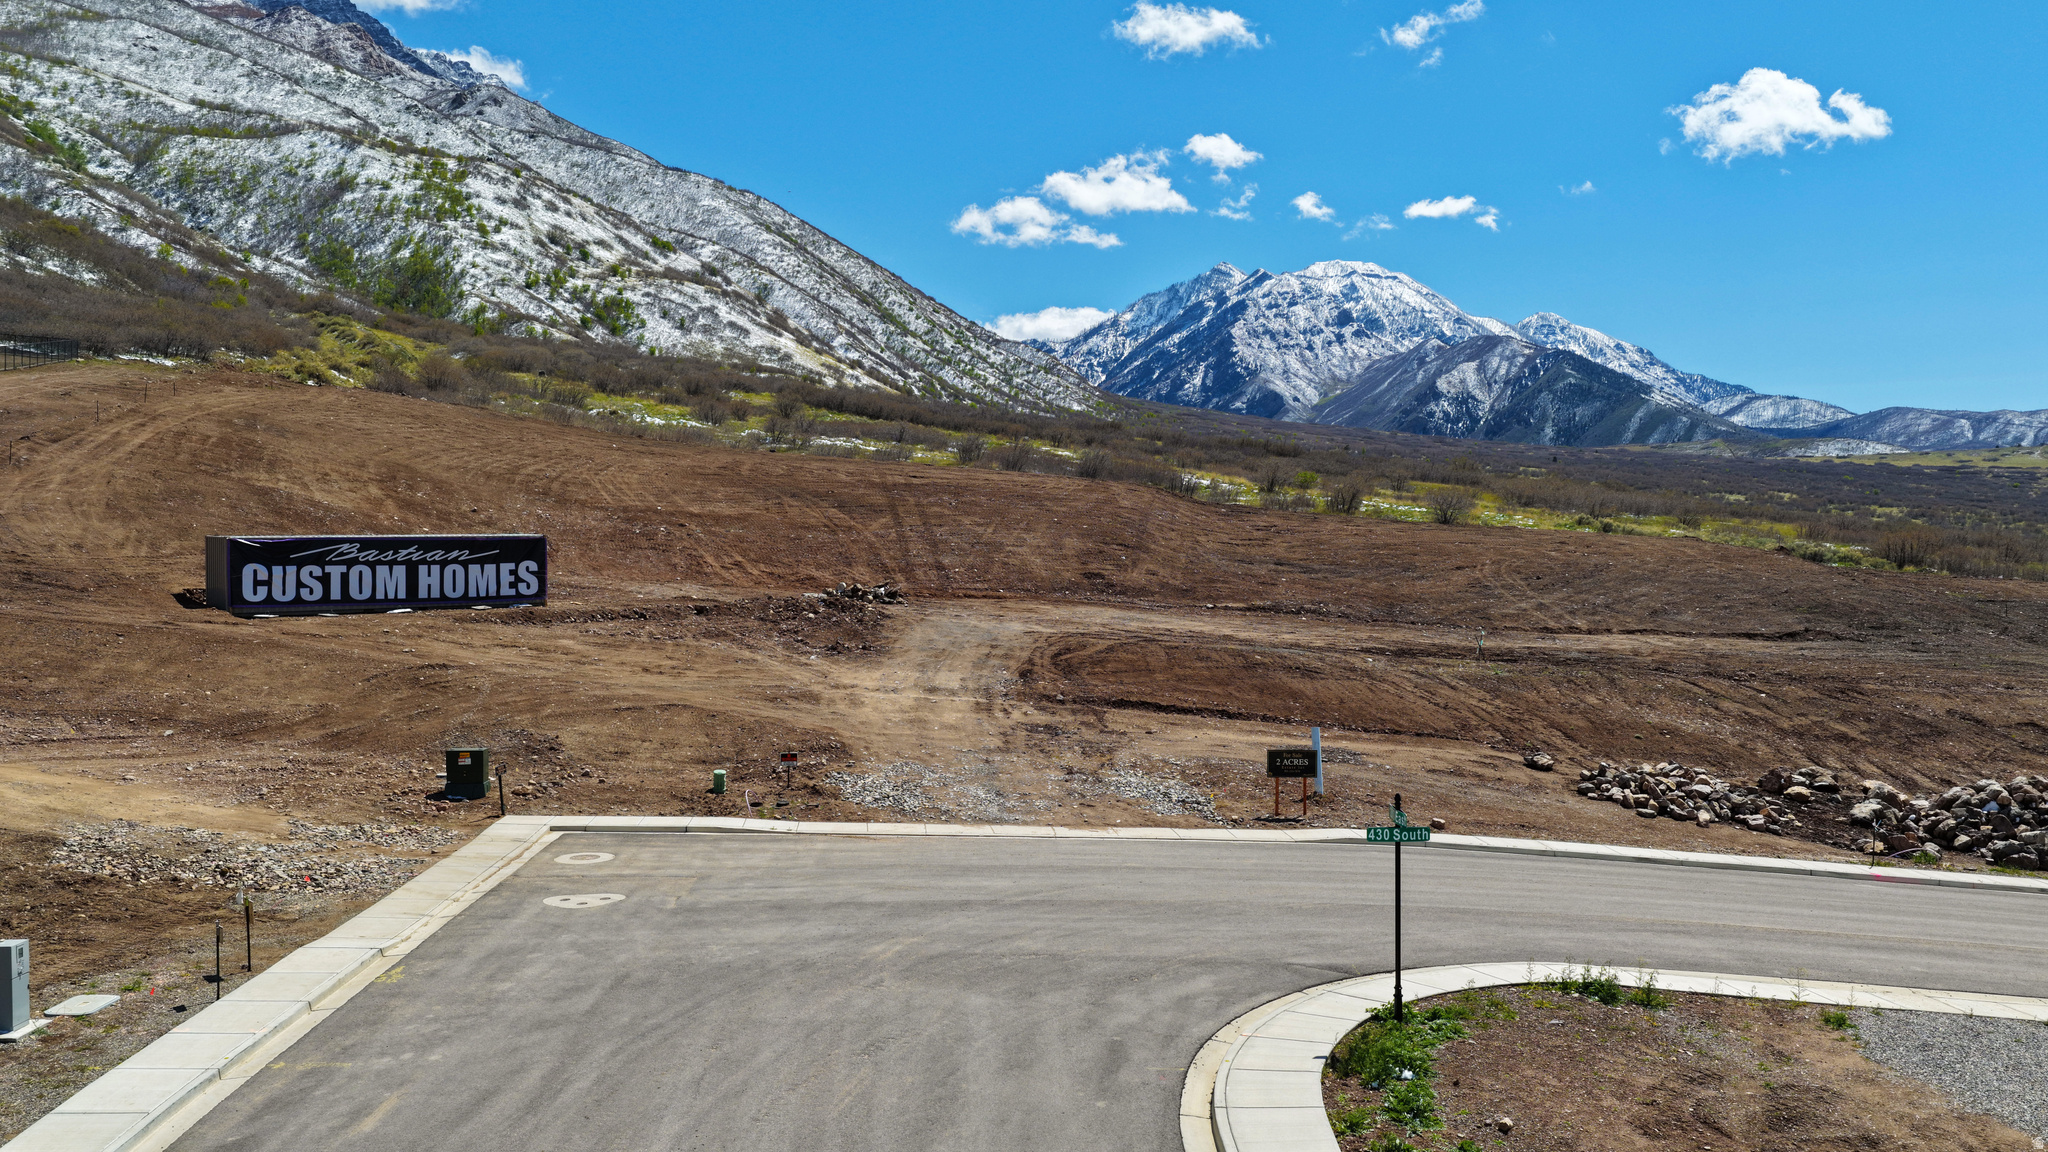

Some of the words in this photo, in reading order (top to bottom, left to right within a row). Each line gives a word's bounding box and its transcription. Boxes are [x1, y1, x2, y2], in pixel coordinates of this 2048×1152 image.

[290, 543, 499, 562] Bastian
[242, 563, 406, 602] CUSTOM
[418, 561, 539, 598] HOMES
[1368, 829, 1390, 840] 430
[1393, 829, 1429, 840] South
